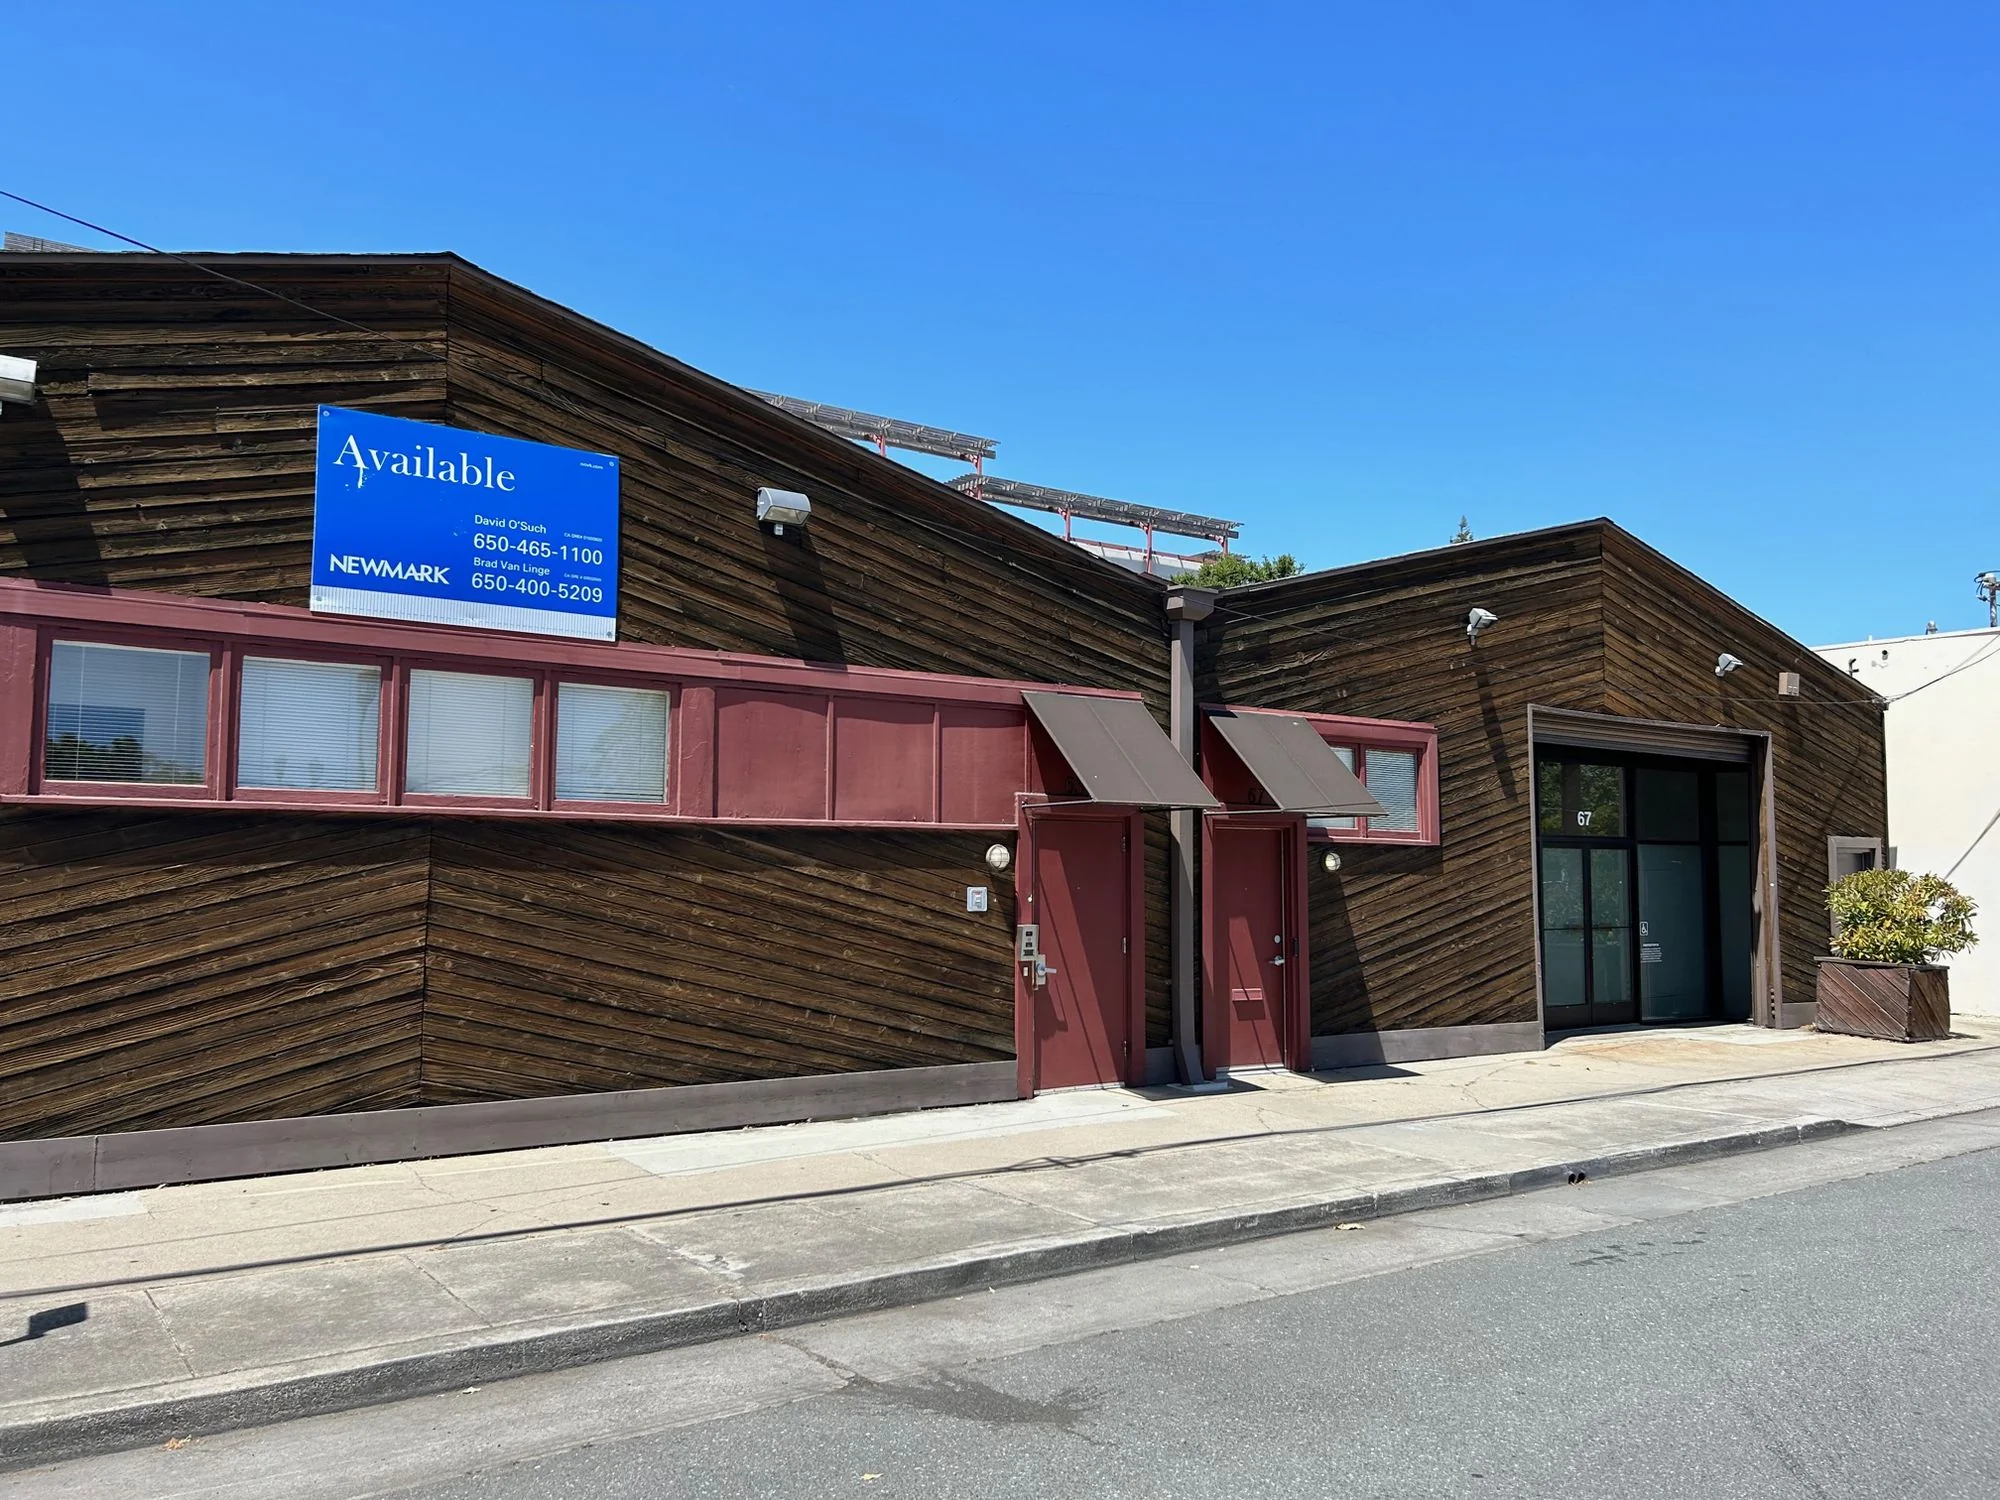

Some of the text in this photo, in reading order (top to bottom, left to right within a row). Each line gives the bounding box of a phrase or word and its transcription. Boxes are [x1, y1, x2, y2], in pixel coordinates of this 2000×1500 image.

[332, 434, 515, 491] Available
[473, 514, 547, 535] David O'Such
[472, 532, 603, 565] 650-465-1100
[329, 553, 450, 585] NEWMARK
[472, 556, 498, 569] Brad
[500, 560, 520, 573] Van
[522, 563, 550, 577] Linge
[470, 572, 603, 603] 650-400-5209
[1577, 811, 1592, 826] 67
